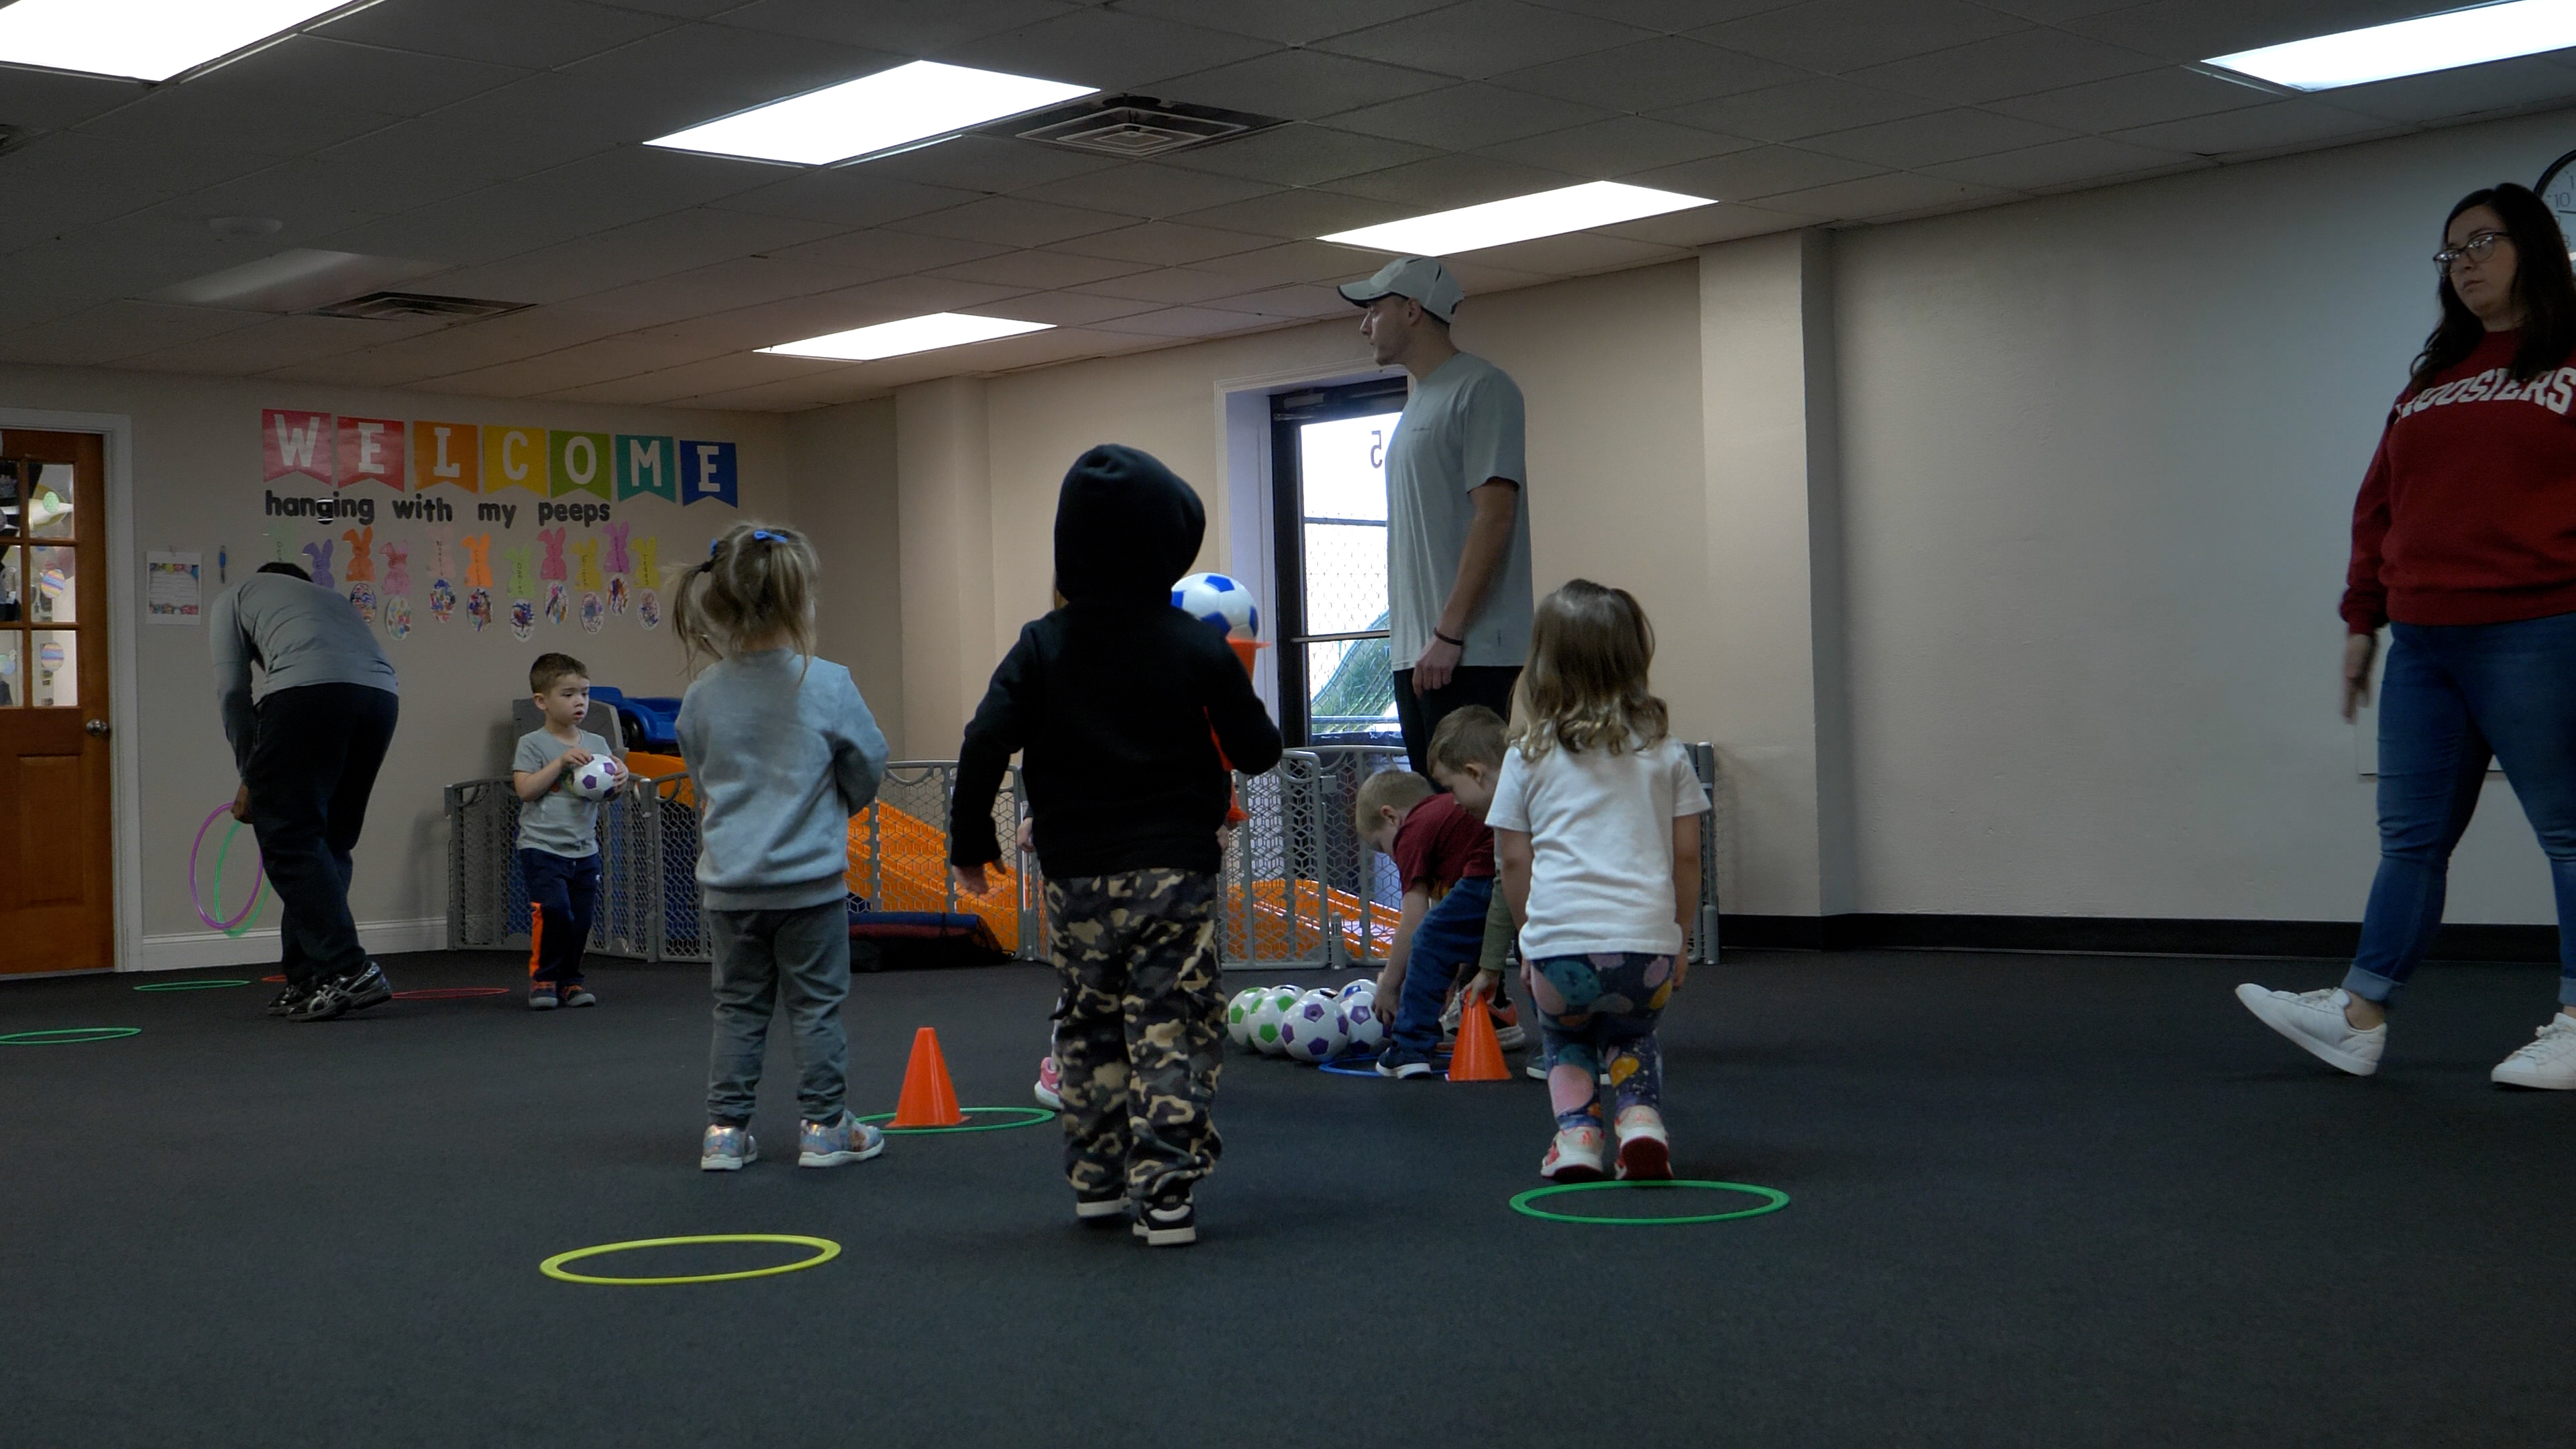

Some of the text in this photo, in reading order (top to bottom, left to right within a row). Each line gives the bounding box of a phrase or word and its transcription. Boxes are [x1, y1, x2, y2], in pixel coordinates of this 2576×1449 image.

[2555, 192, 2571, 208] 10
[274, 414, 721, 492] WELCOME
[265, 491, 611, 529] hanging with my peeps
